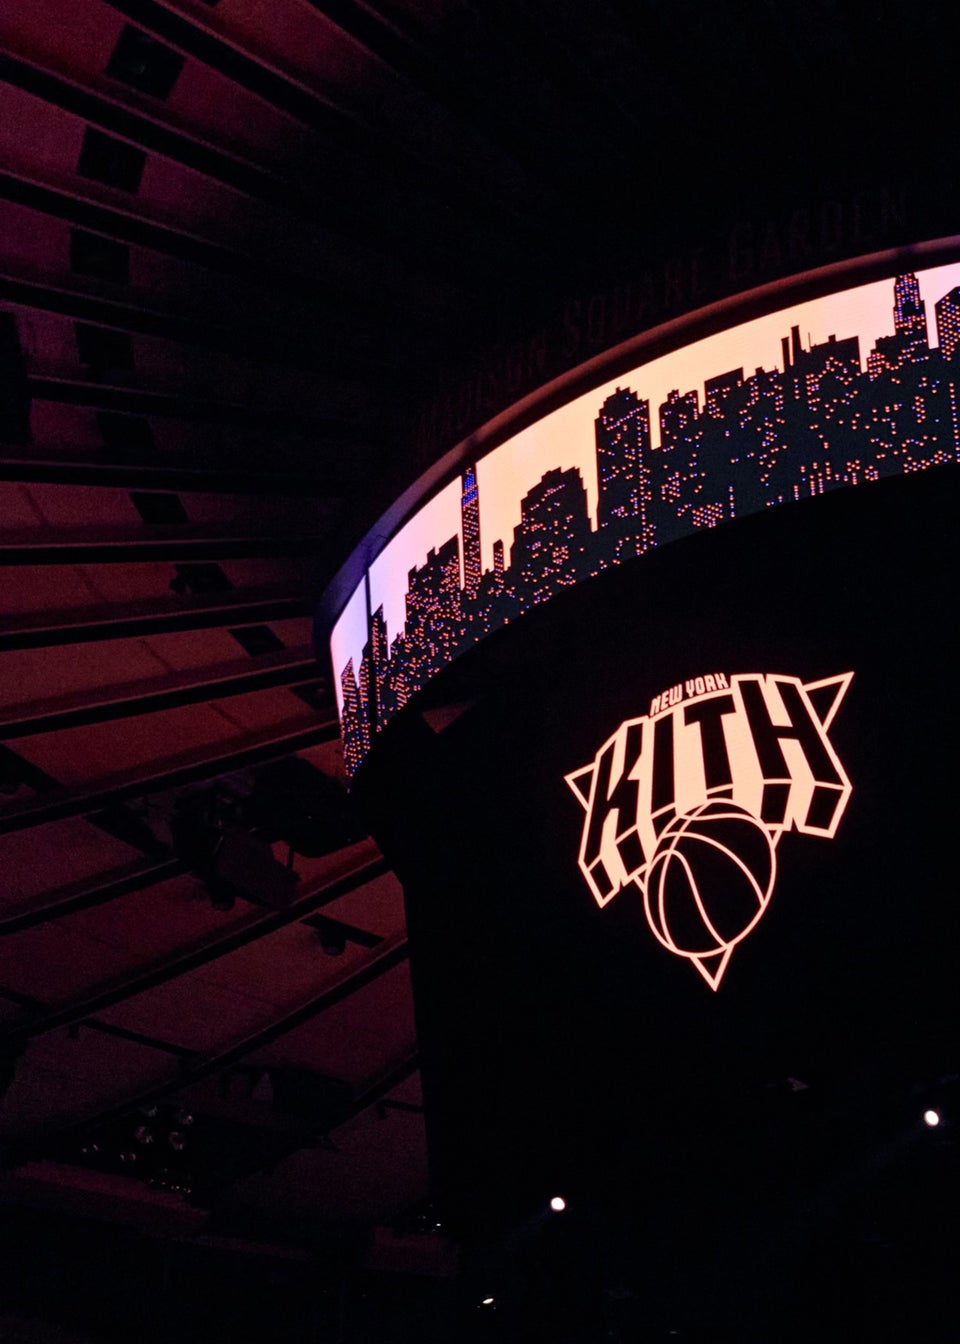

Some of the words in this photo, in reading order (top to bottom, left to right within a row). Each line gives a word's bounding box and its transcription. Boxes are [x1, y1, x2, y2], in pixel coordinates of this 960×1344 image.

[726, 184, 909, 283] GARDEN
[650, 684, 682, 716] NEW
[685, 673, 729, 698] YORK
[564, 671, 855, 908] KITH
